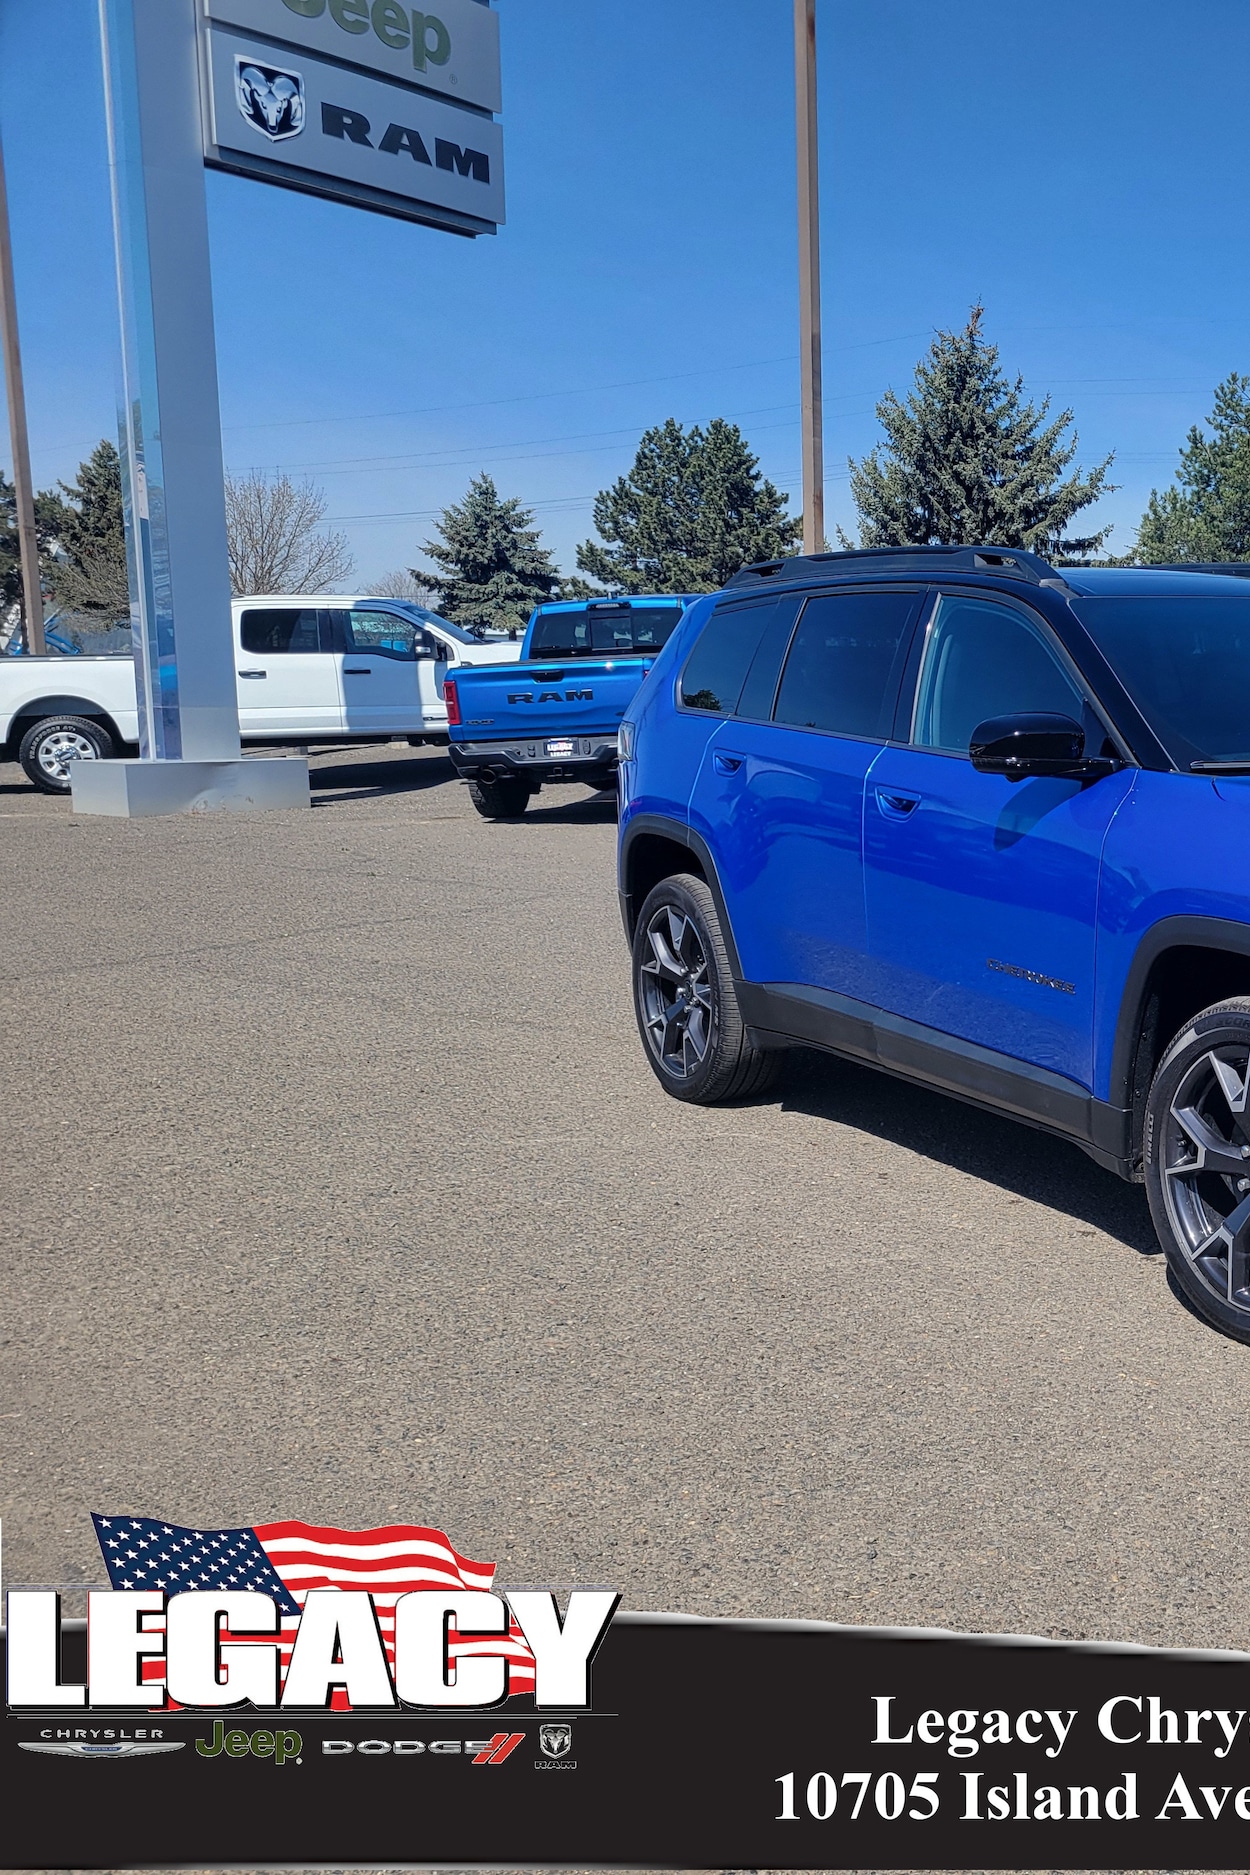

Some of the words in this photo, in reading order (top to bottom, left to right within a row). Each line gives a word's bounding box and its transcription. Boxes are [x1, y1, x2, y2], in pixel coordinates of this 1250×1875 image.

[281, 0, 451, 72] eep
[320, 101, 491, 185] RAM
[507, 689, 593, 704] RAM
